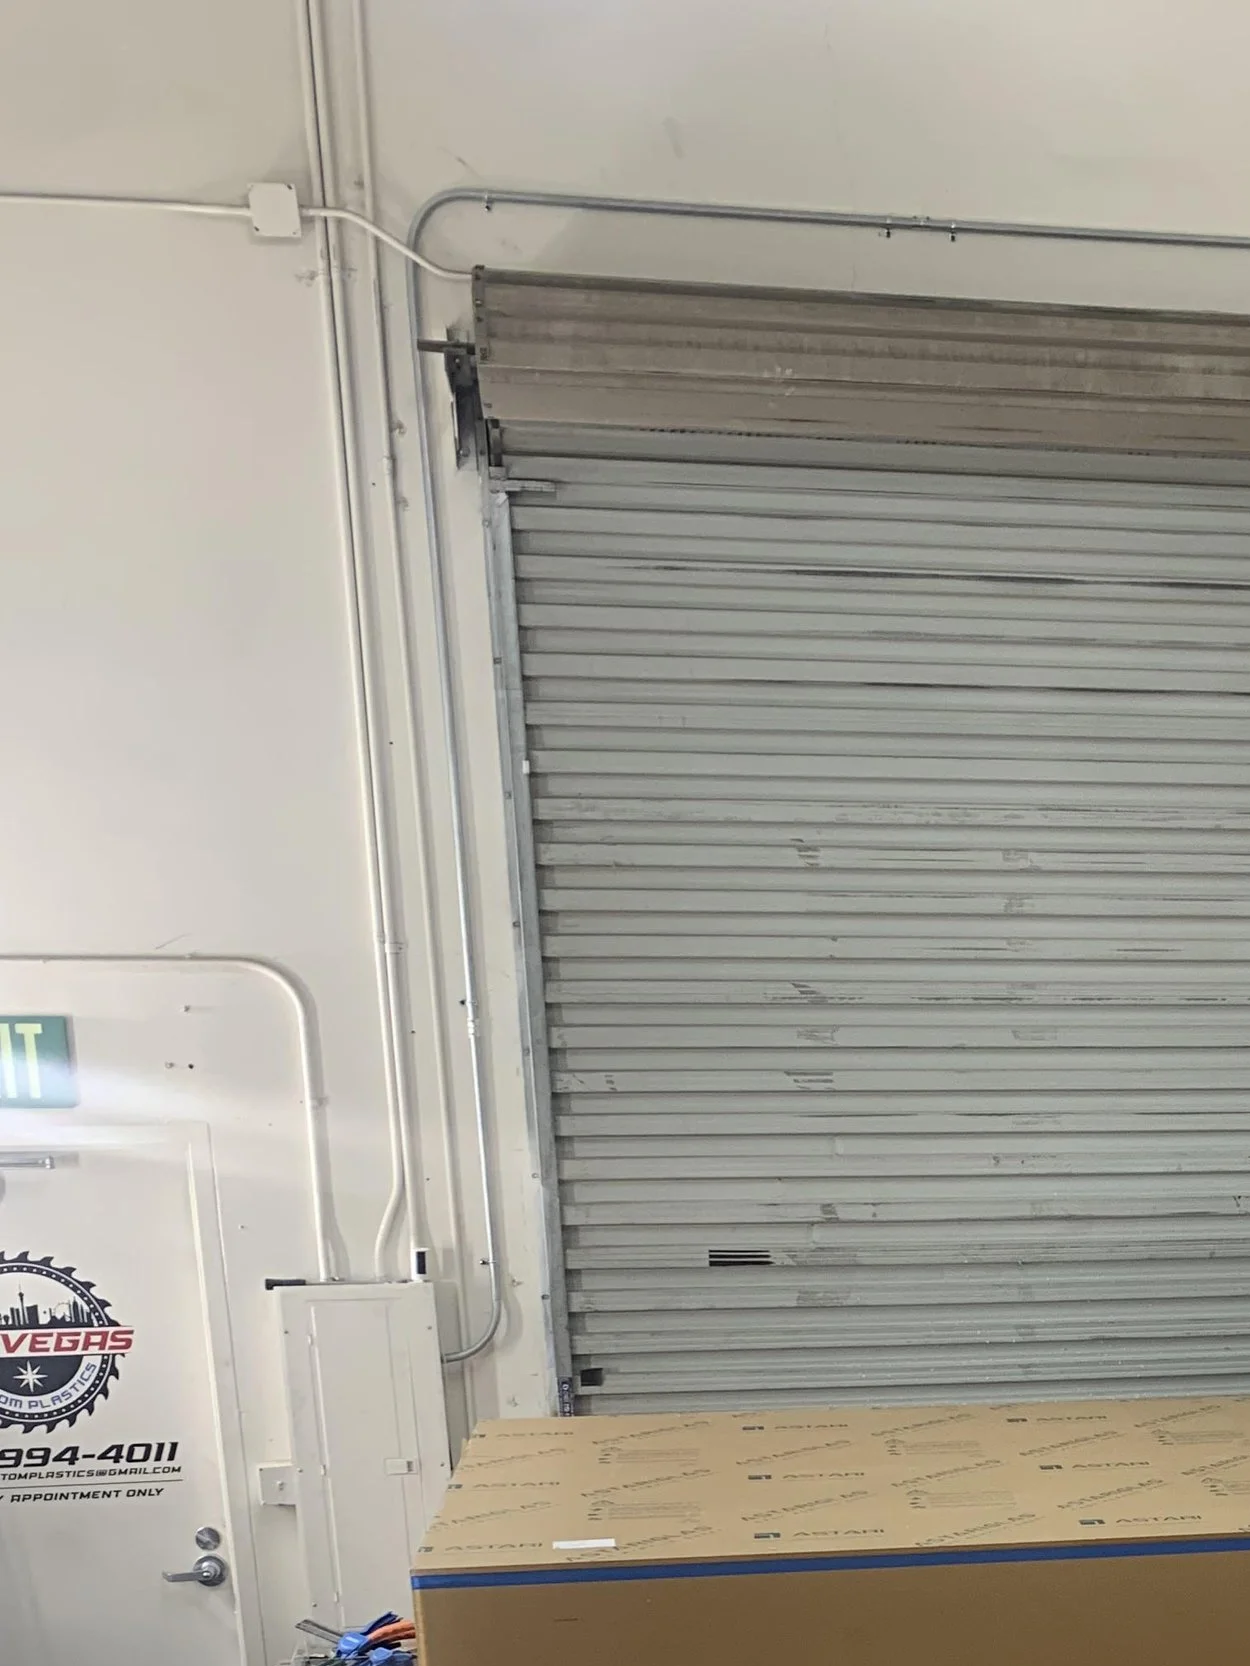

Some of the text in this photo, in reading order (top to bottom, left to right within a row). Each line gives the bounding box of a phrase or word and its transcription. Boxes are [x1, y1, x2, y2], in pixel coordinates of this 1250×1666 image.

[0, 1330, 134, 1354] VEGAS
[28, 1362, 97, 1410] PLASTICS
[0, 1442, 178, 1468] 994-4011
[10, 1489, 122, 1503] APPOINTMENT
[126, 1488, 164, 1498] ONLY
